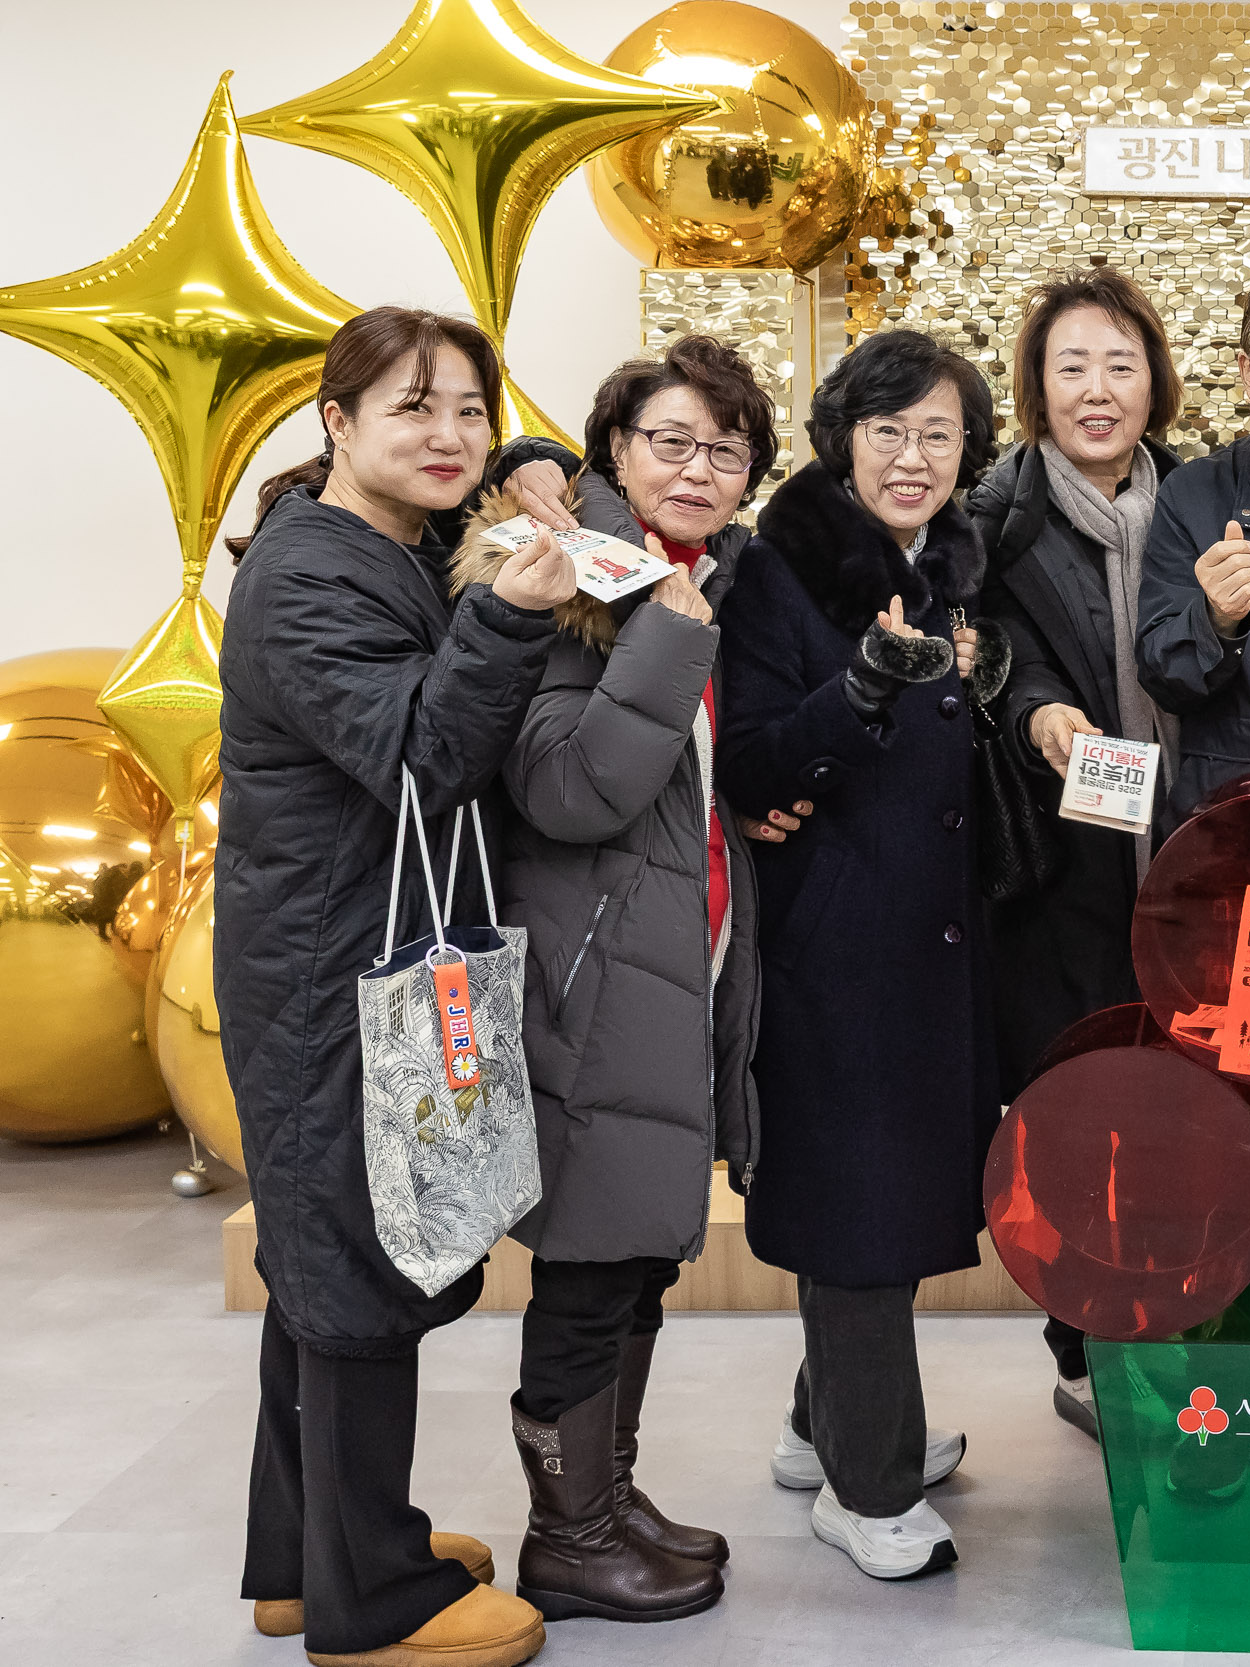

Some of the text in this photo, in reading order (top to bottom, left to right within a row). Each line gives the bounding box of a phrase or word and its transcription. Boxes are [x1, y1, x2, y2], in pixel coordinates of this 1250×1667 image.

[1117, 137, 1200, 180] 광진
[1082, 744, 1147, 768] 겨울나기
[1079, 758, 1145, 785] 따뜻한
[1117, 785, 1142, 796] 2026
[447, 1004, 471, 1051] JHR
